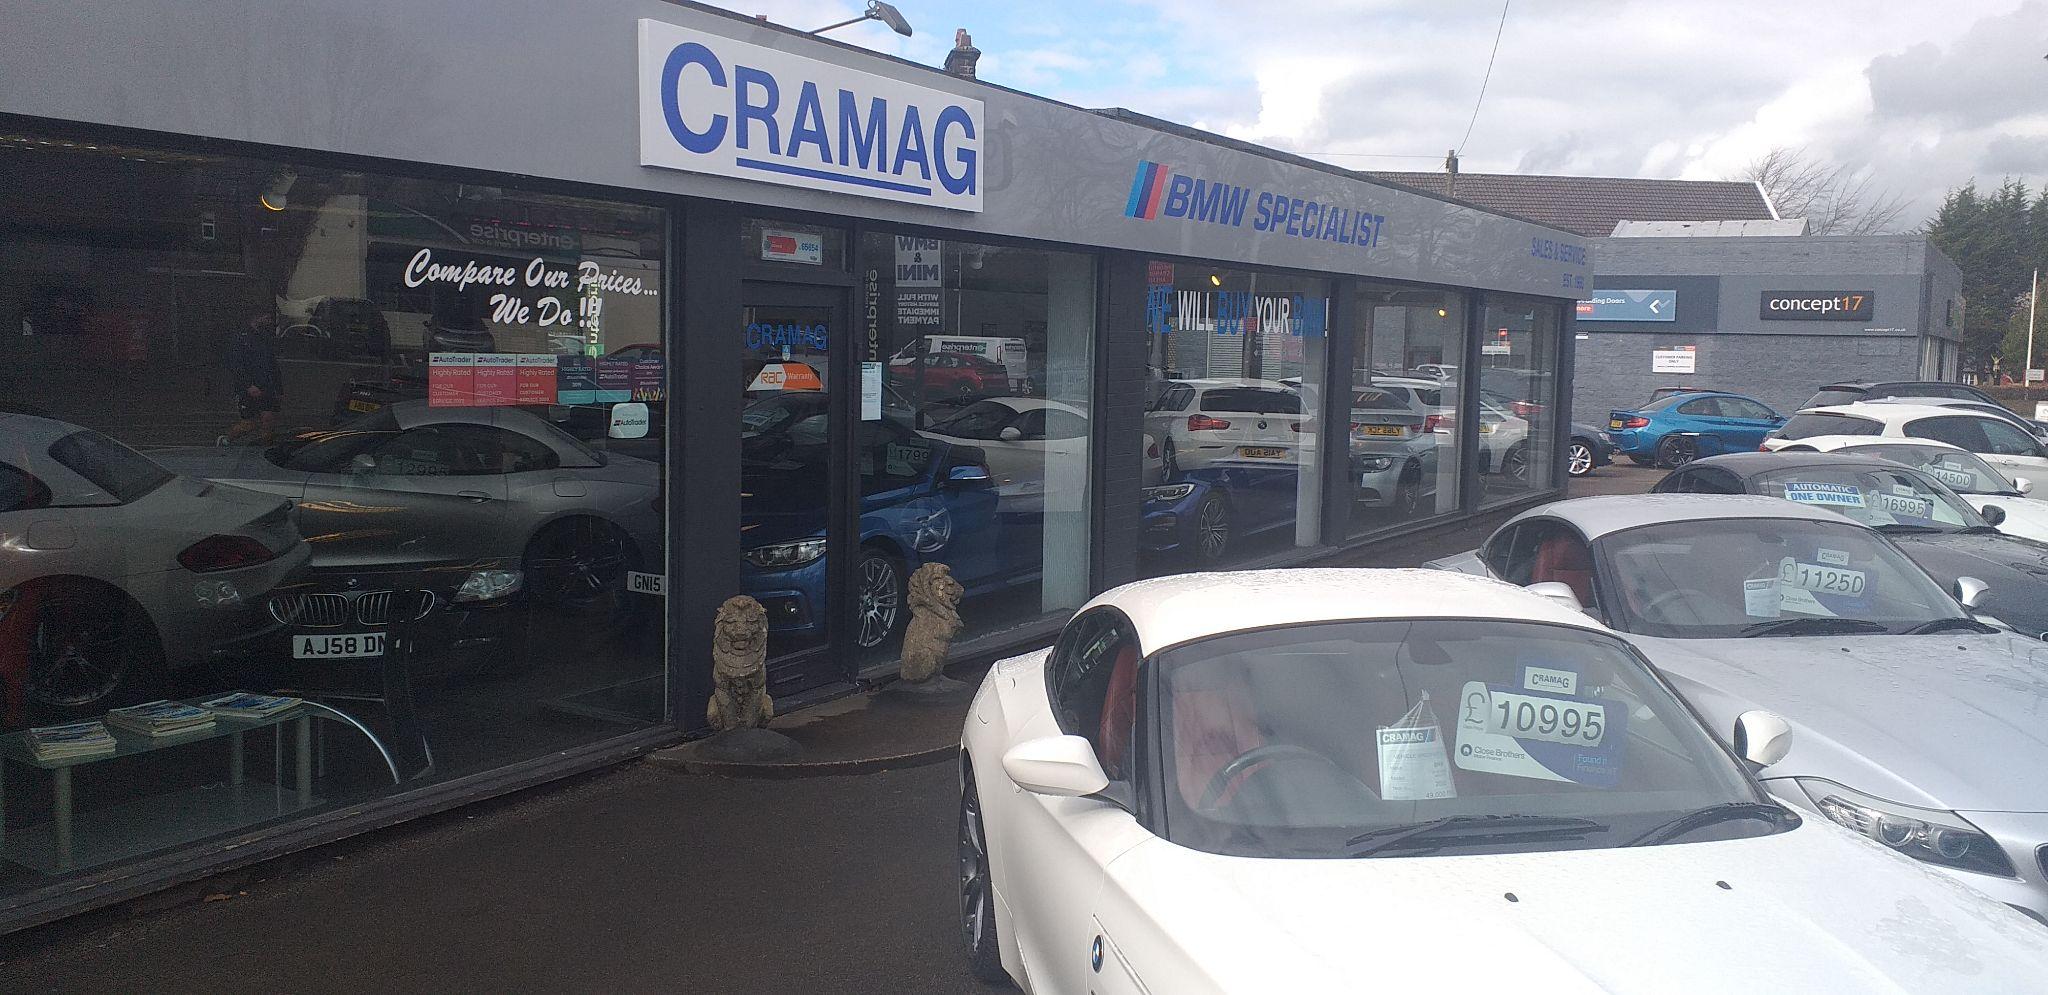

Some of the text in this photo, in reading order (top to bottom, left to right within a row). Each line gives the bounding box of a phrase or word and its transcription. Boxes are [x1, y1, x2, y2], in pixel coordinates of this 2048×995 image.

[661, 42, 976, 196] CRAMAG
[1164, 174, 1384, 248] BMW SPECIALIST
[404, 248, 516, 292] Compare
[525, 257, 569, 289] Our
[490, 294, 529, 324] We
[537, 297, 572, 326] Do
[1178, 290, 1213, 331] WILL
[1218, 291, 1250, 336] BUY
[1255, 296, 1289, 333] YOUR
[1770, 295, 1864, 314] concept17
[746, 323, 827, 350] CRAMAG
[432, 369, 452, 377] Highly
[1791, 493, 1860, 504] ONE OWNER
[1793, 484, 1853, 494] AUTOMATIC
[1883, 498, 1925, 515] 16995
[1801, 569, 1863, 593] 11250
[303, 637, 357, 655] AJ58
[1532, 673, 1569, 688] CRAMAG
[1465, 692, 1602, 740] £ 10995
[1382, 733, 1424, 743] CRAMAG
[1474, 746, 1525, 760] Close Brothers
